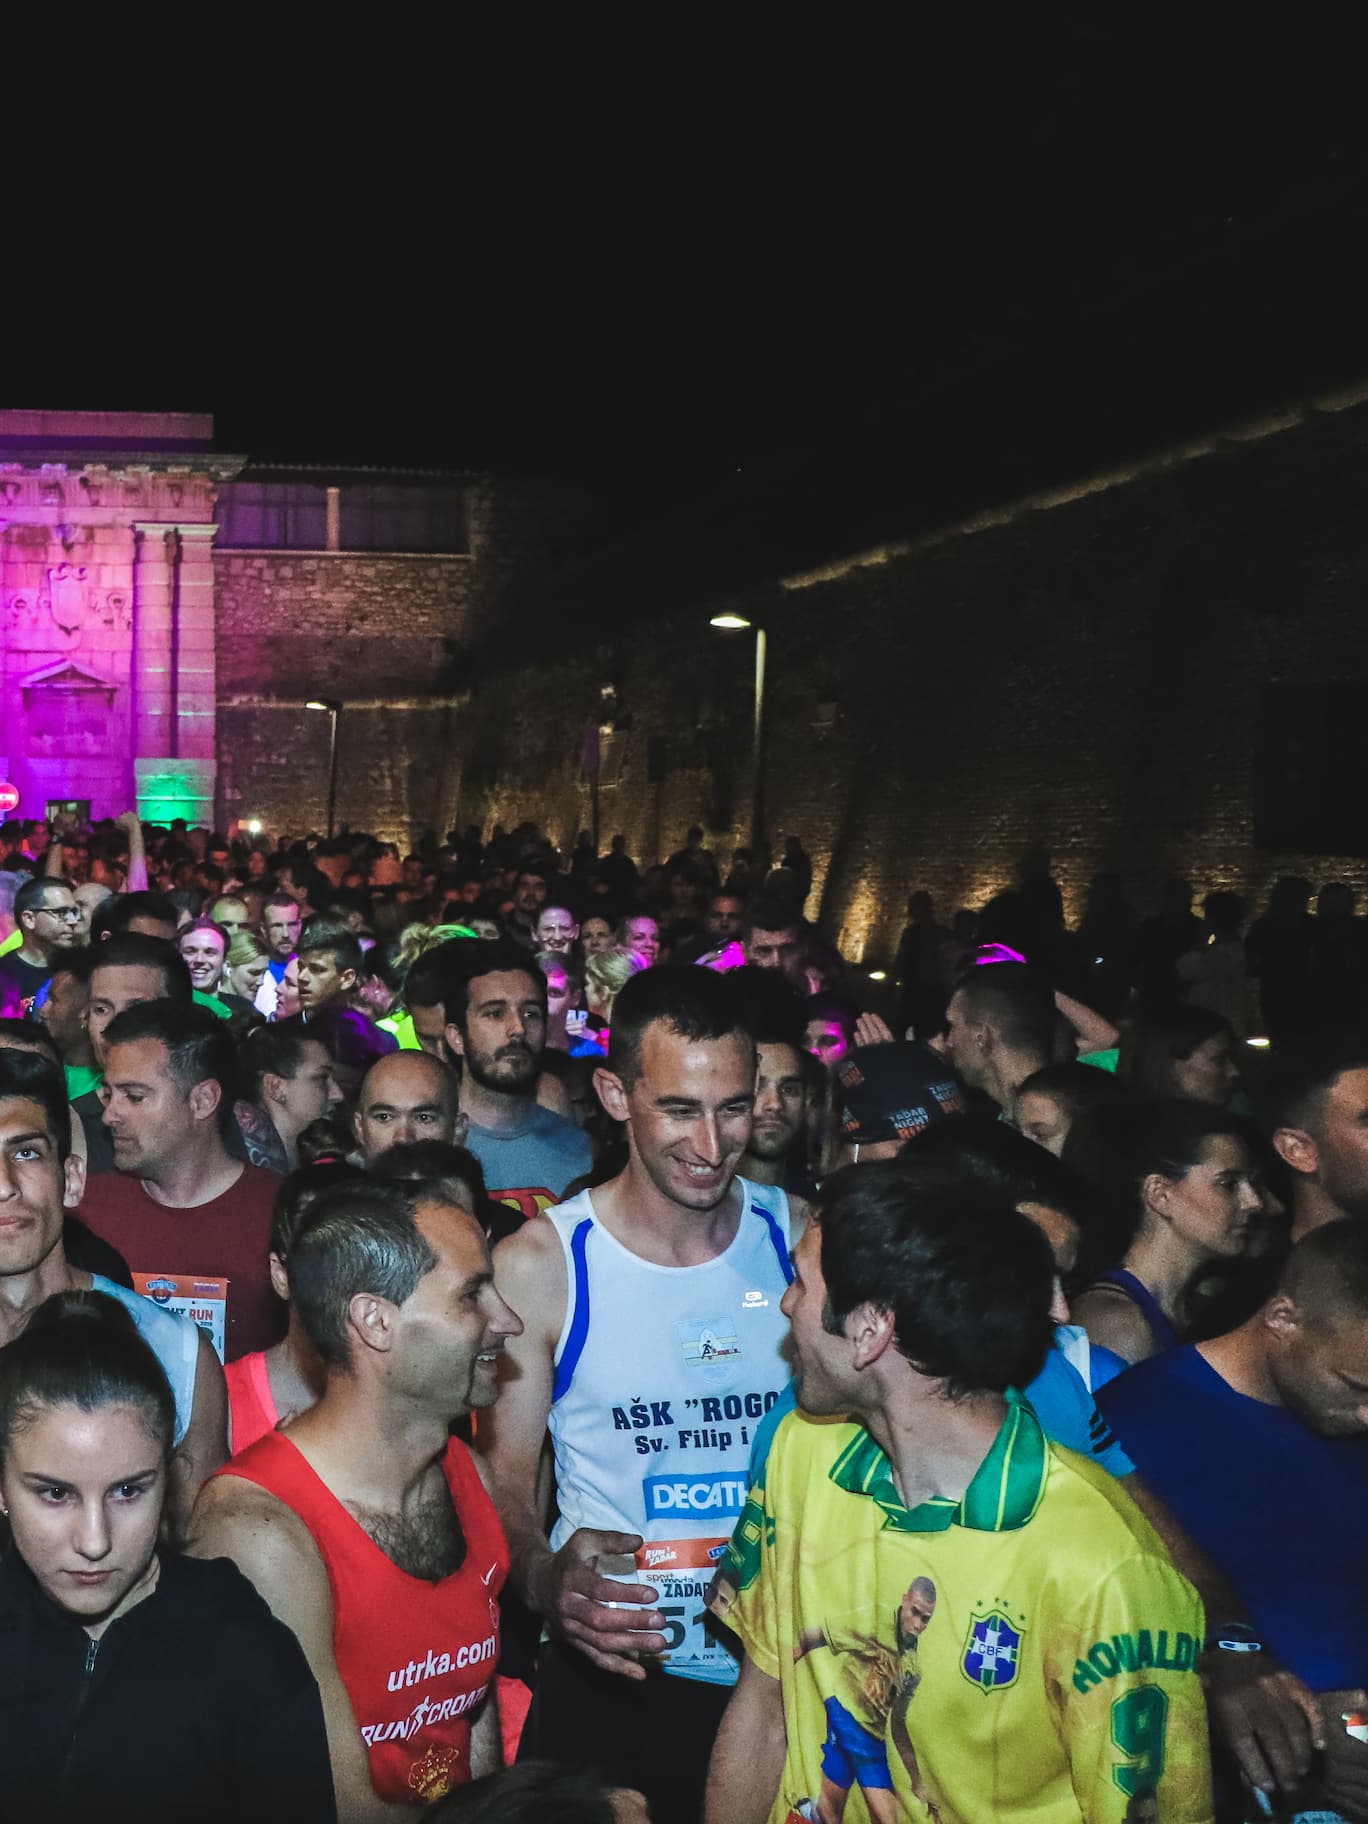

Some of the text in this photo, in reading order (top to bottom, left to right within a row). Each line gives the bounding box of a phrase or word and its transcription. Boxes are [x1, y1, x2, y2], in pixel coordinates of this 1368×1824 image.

[189, 1308, 214, 1321] RUN
[612, 1397, 674, 1430] AŠK
[635, 1426, 750, 1455] Sv. Filip i
[388, 1635, 496, 1693] utrka.com
[979, 1643, 1003, 1656] CBF
[1072, 1629, 1200, 1694] RONALD
[1111, 1683, 1170, 1800] 9
